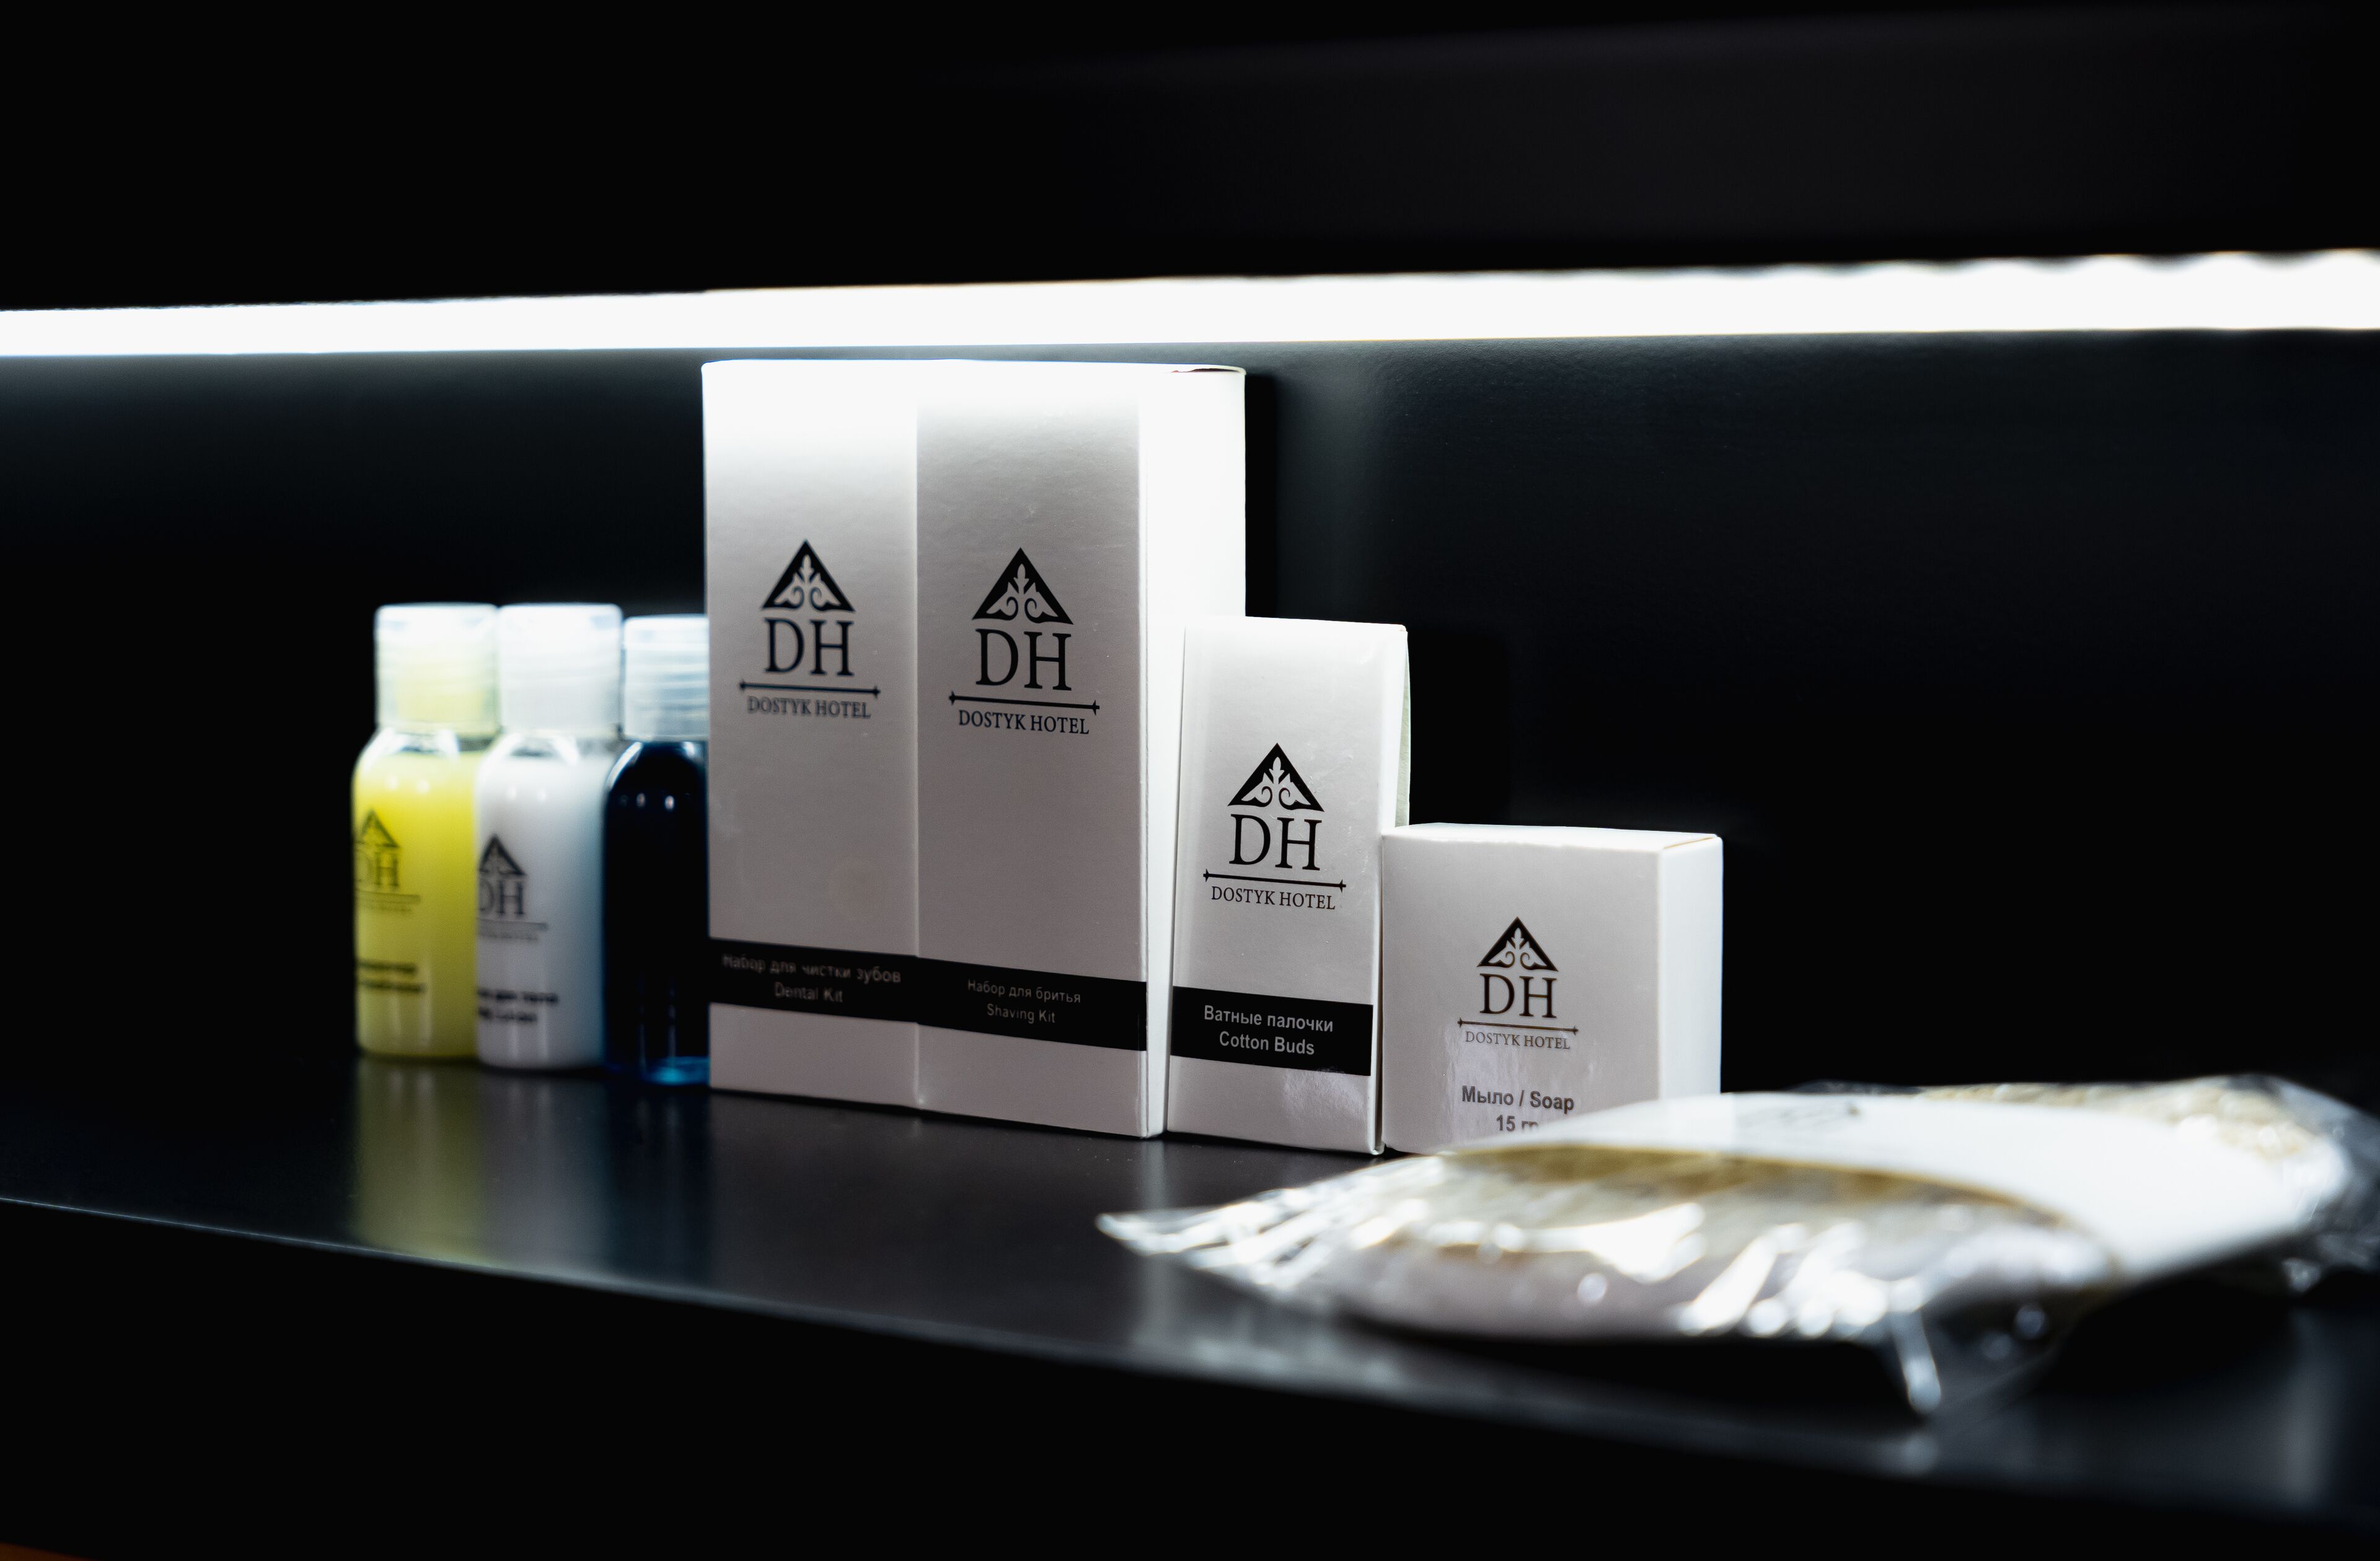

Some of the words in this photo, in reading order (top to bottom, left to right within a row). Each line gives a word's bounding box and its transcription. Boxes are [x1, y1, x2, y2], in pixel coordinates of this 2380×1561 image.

[764, 617, 855, 677] DH
[975, 628, 1072, 692] DH
[747, 695, 811, 715] DOSTYK
[815, 698, 871, 719] HOTEL
[958, 710, 1026, 731] DOSTYK
[1030, 716, 1090, 735] HOTEL
[1228, 814, 1323, 871] DH
[1211, 886, 1276, 905] DOSTYK
[1279, 892, 1336, 910] HOTEL
[857, 965, 902, 984] зубов
[775, 982, 819, 1001] Dental
[823, 987, 844, 1003] Kit
[967, 978, 1005, 998] Набор
[1008, 987, 1031, 998] для
[1036, 987, 1081, 1003] бритья
[1479, 973, 1558, 1018] DH
[987, 1003, 1034, 1024] Shaving
[1039, 1009, 1056, 1023] Kit
[1204, 1005, 1262, 1026] Ватные
[1267, 1014, 1333, 1032] палочки
[1219, 1031, 1269, 1051] Cotton
[1274, 1036, 1315, 1055] Buds
[1465, 1031, 1520, 1046] DOSTYK
[1523, 1036, 1571, 1050] HOTEL
[1461, 1085, 1514, 1106] Мыло
[1518, 1089, 1525, 1107] /
[1530, 1091, 1574, 1114] Soap
[1496, 1114, 1516, 1132] 15
